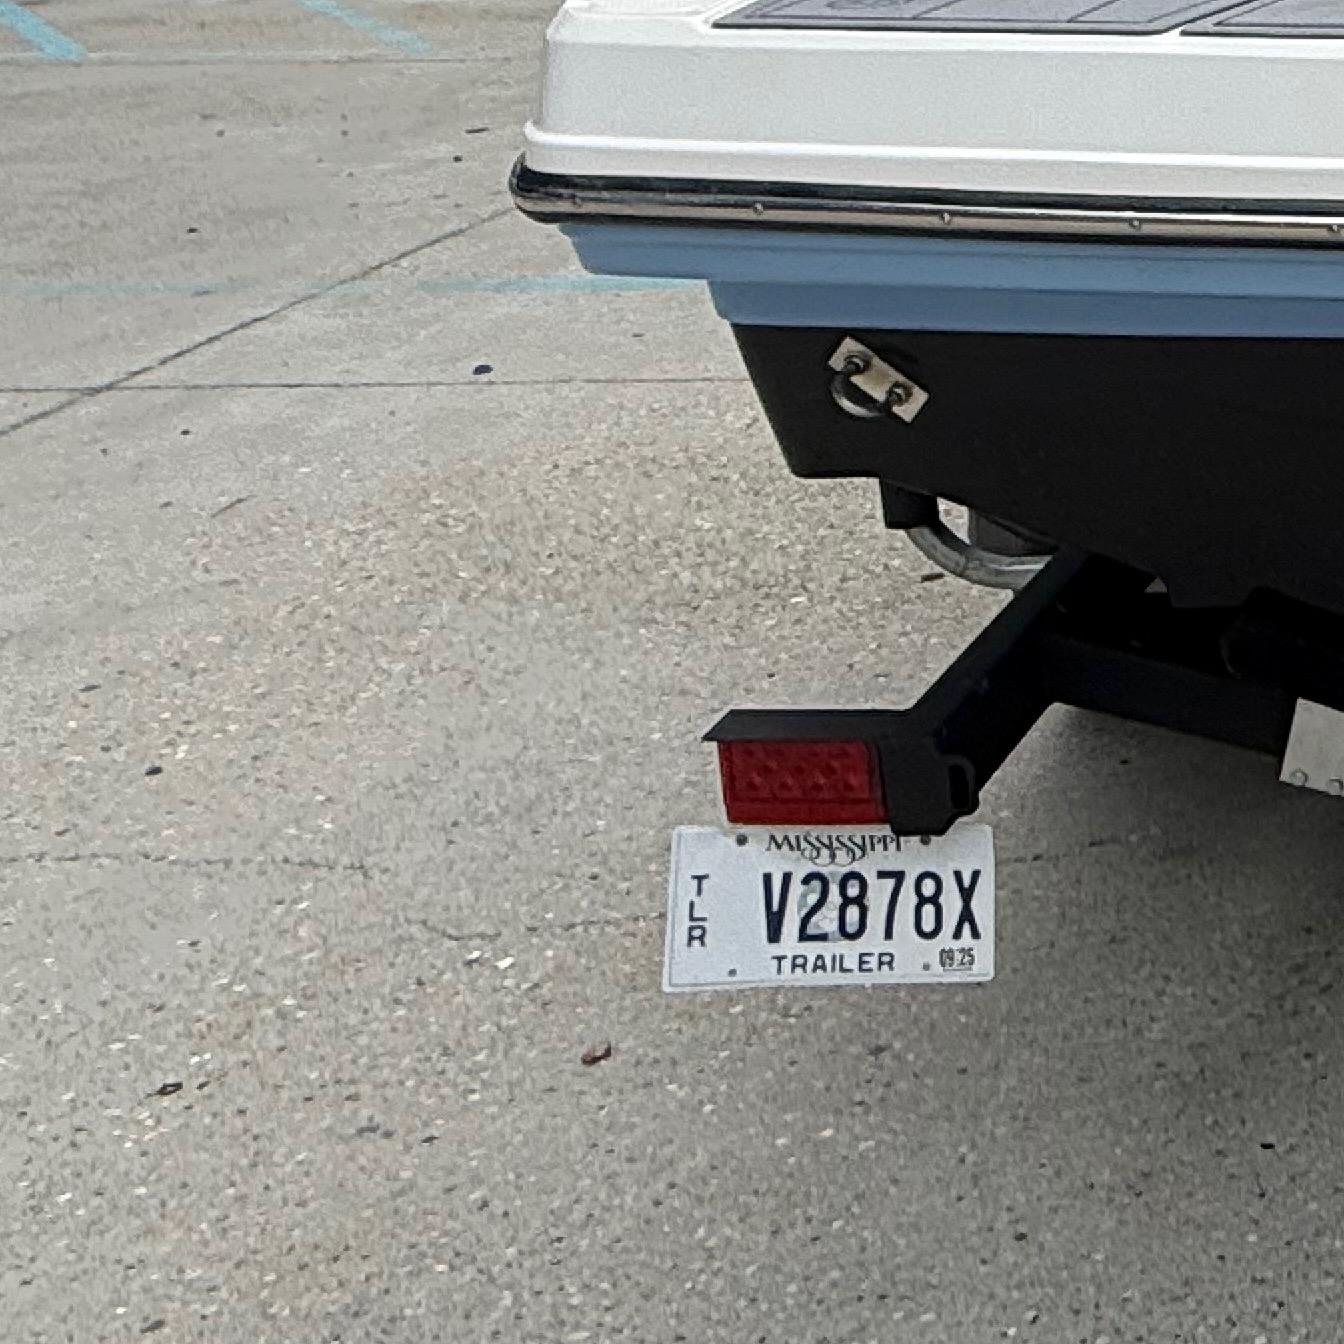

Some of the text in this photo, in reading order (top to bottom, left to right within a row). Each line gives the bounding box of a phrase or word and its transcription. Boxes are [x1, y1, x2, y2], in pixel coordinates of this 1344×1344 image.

[765, 833, 902, 867] MISSISSIPPI
[762, 869, 981, 944] V2878X
[771, 952, 896, 975] TRAILER
